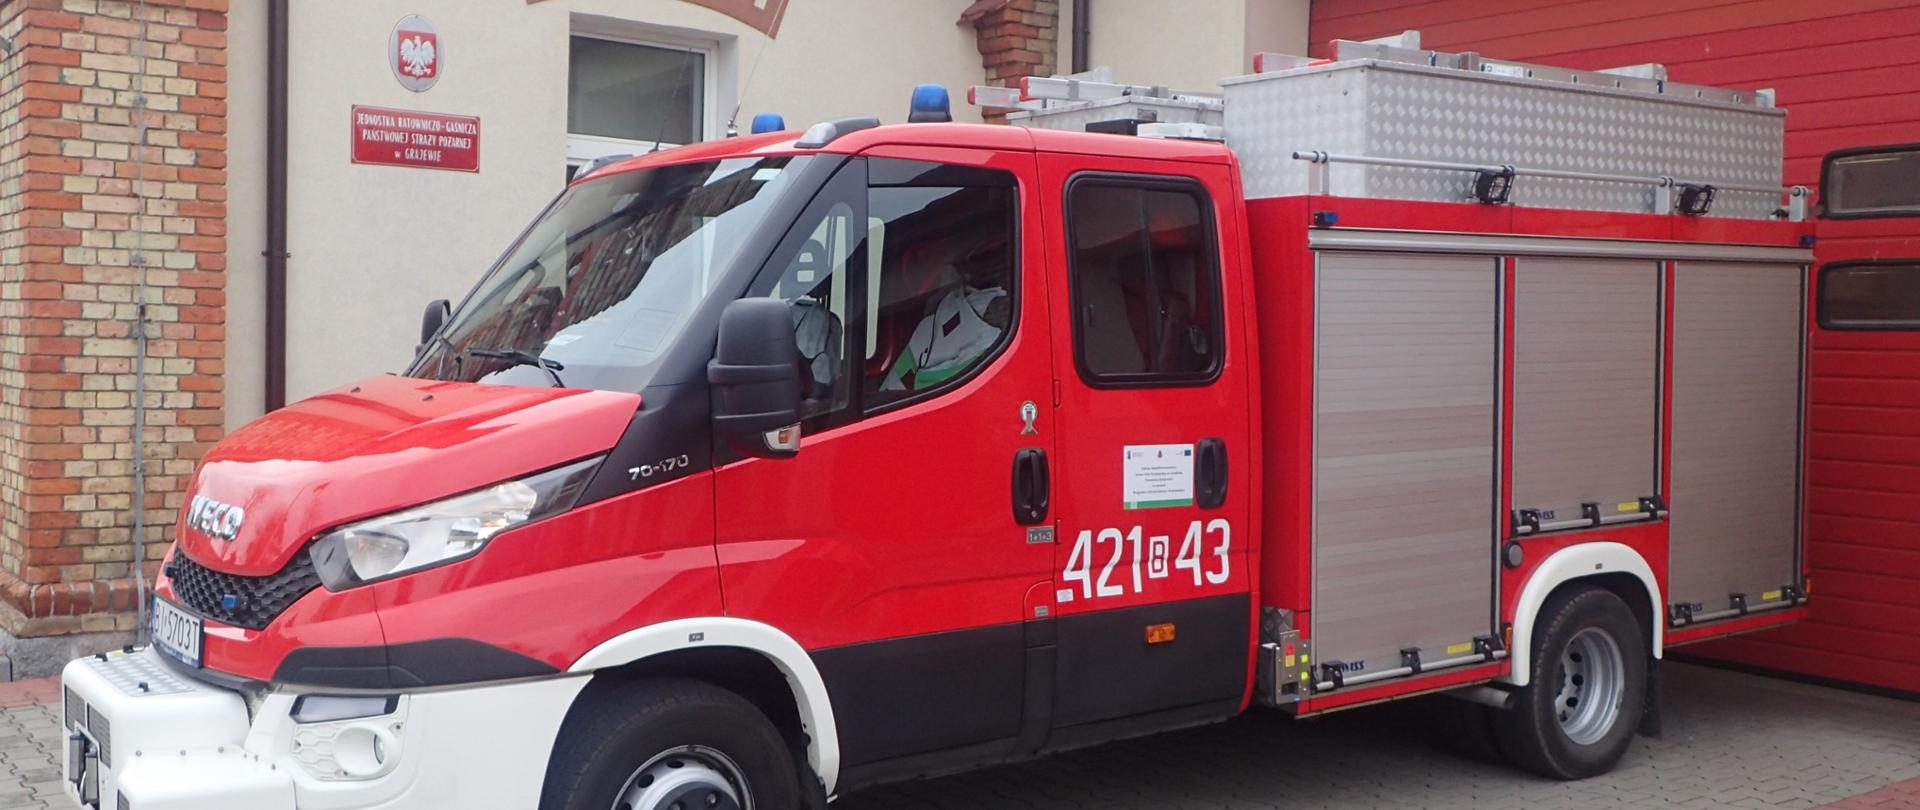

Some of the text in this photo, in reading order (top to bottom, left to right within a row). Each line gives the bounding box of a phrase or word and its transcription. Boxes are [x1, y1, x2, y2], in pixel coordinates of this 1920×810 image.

[357, 113, 395, 127] JEDNOSTKA
[405, 148, 442, 161] GRAJEWIE
[628, 454, 689, 481] 70-170
[187, 495, 245, 542] IVECO
